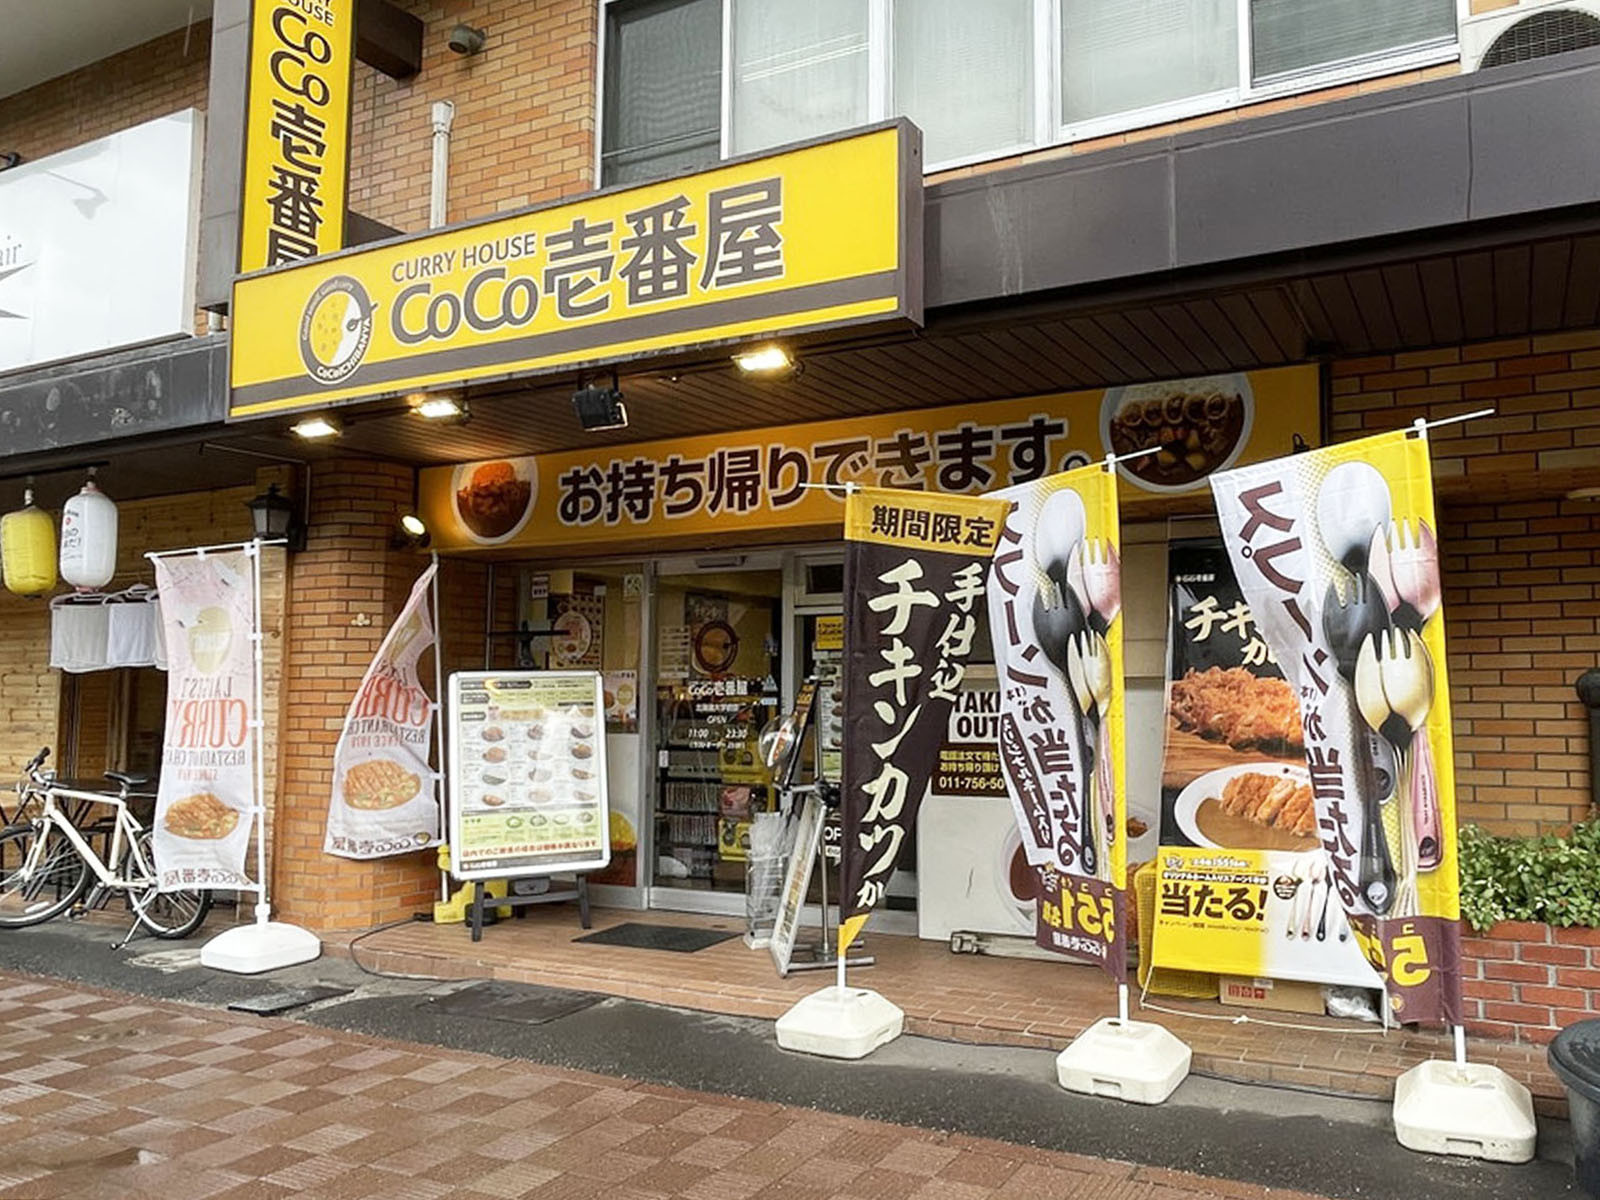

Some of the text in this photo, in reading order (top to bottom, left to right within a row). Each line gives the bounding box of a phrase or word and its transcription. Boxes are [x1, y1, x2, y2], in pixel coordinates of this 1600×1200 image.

[391, 177, 784, 345] CoCo壱番屋
[392, 233, 536, 282] CURRY HOUSE
[558, 417, 1091, 523] お持ち帰りできます。
[872, 505, 995, 549] 期間限定
[928, 562, 986, 700] 手仕込
[957, 716, 1000, 738] OUT
[1161, 882, 1268, 921] 当たる!
